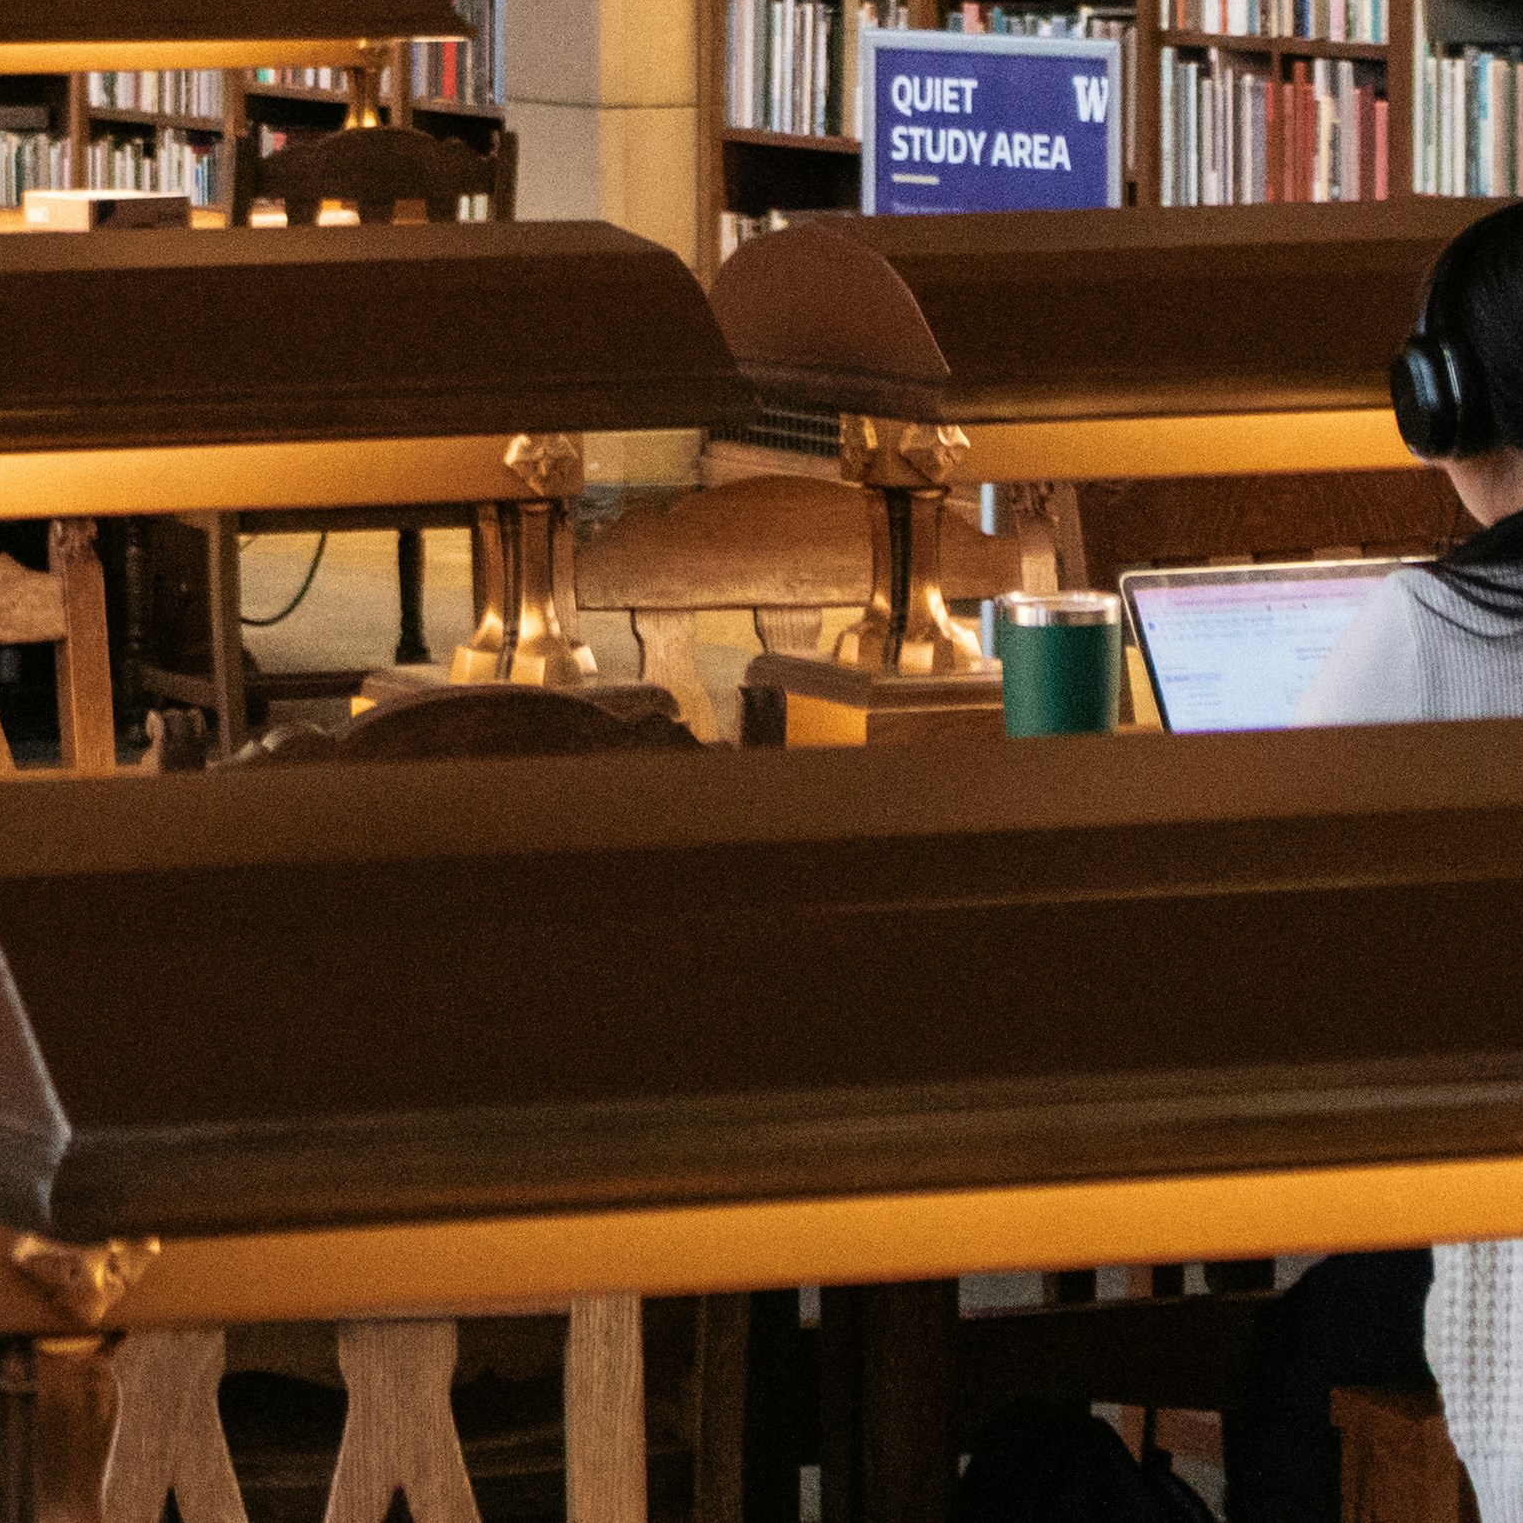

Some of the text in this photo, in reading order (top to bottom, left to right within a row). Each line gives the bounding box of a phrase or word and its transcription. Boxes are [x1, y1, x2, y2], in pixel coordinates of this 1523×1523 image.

[890, 74, 979, 116] QUIET
[1072, 75, 1109, 123] W
[890, 124, 1072, 172] STUDY AREA
